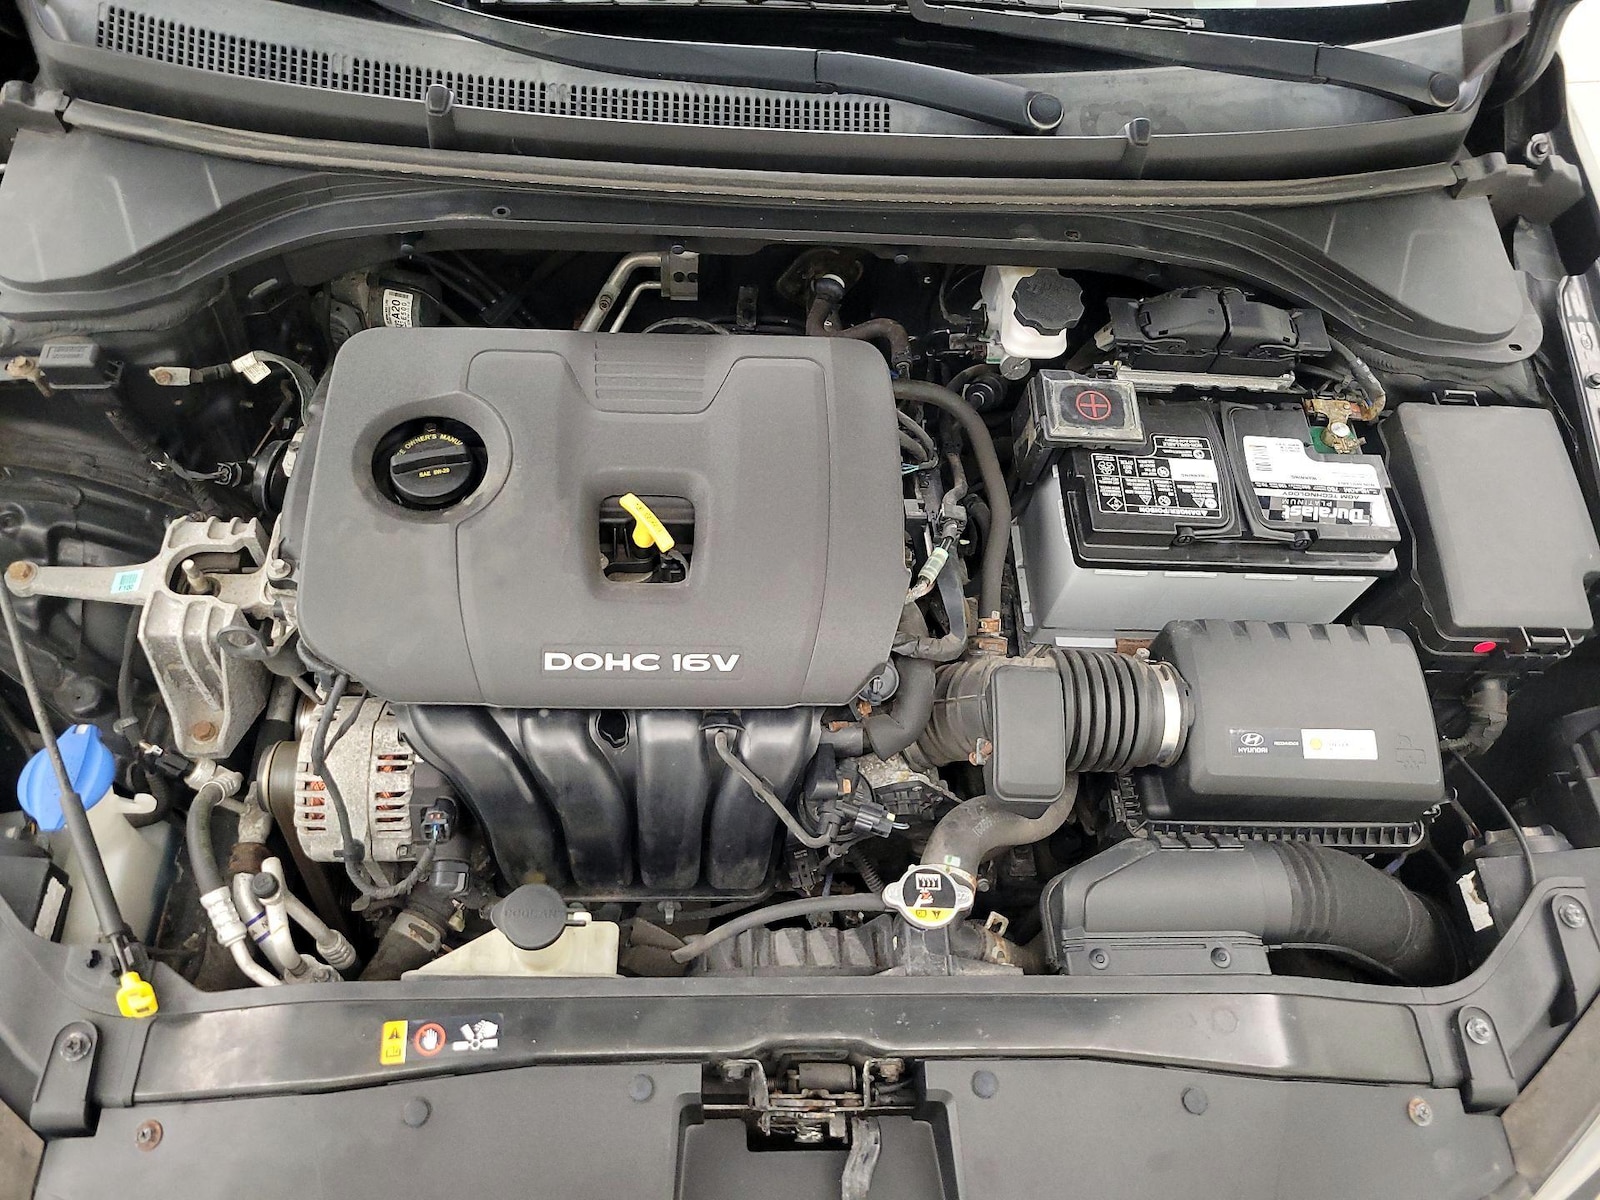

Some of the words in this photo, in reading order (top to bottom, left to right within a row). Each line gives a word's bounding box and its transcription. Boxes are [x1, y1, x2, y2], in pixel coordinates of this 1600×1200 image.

[405, 434, 437, 449] OWNER'S
[1282, 491, 1337, 499] TECHNOLOGY
[1282, 498, 1332, 507] PLATINUM
[1282, 504, 1370, 524] Duralast
[544, 652, 661, 671] DOHC
[672, 653, 741, 672] 16V
